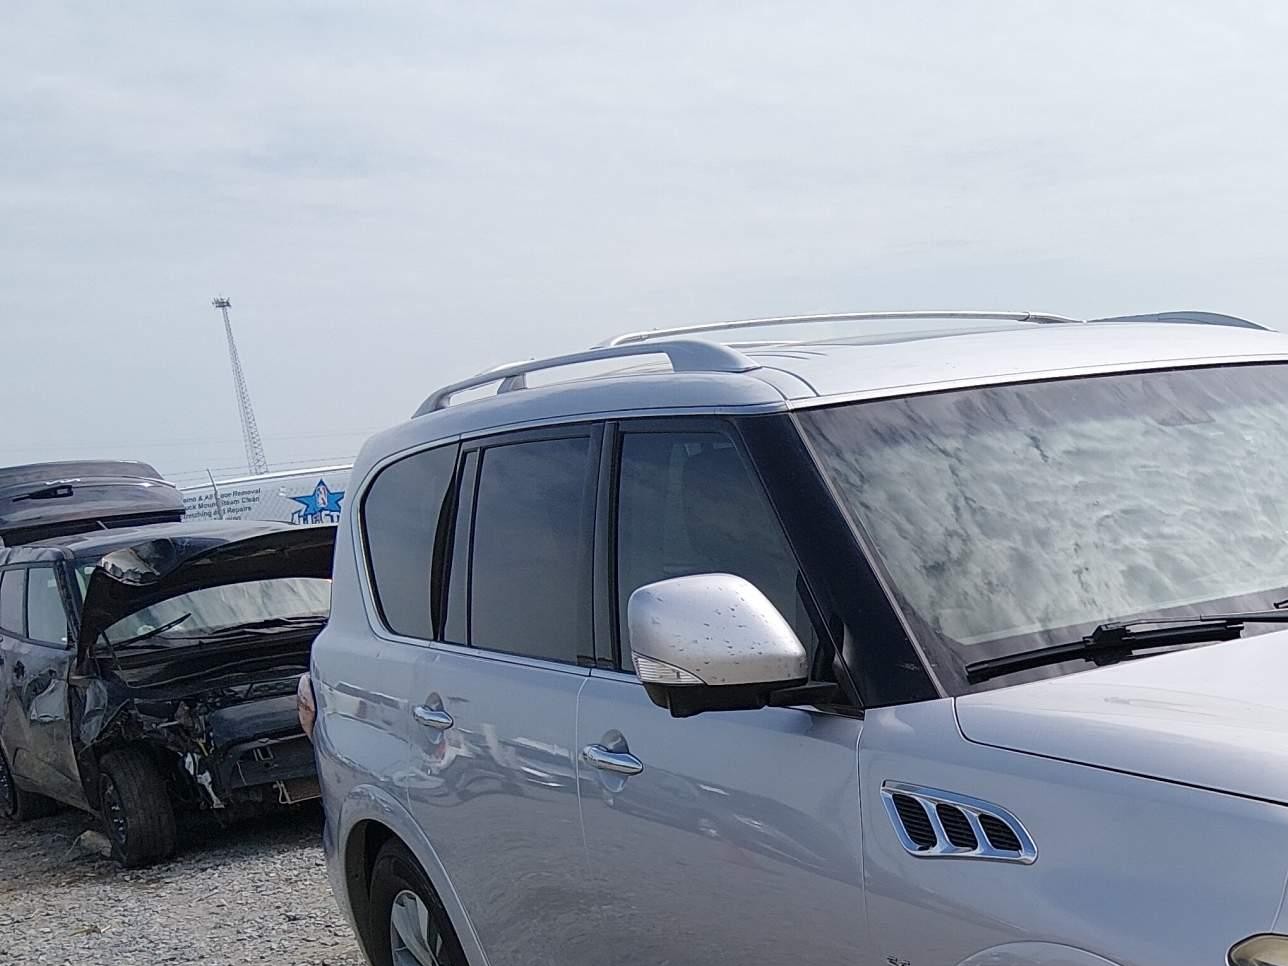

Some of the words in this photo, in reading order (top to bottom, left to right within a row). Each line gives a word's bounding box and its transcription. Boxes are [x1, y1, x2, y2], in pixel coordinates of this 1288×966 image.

[233, 487, 261, 497] Removal
[241, 496, 260, 504] Clean
[227, 505, 252, 516] Repairs
